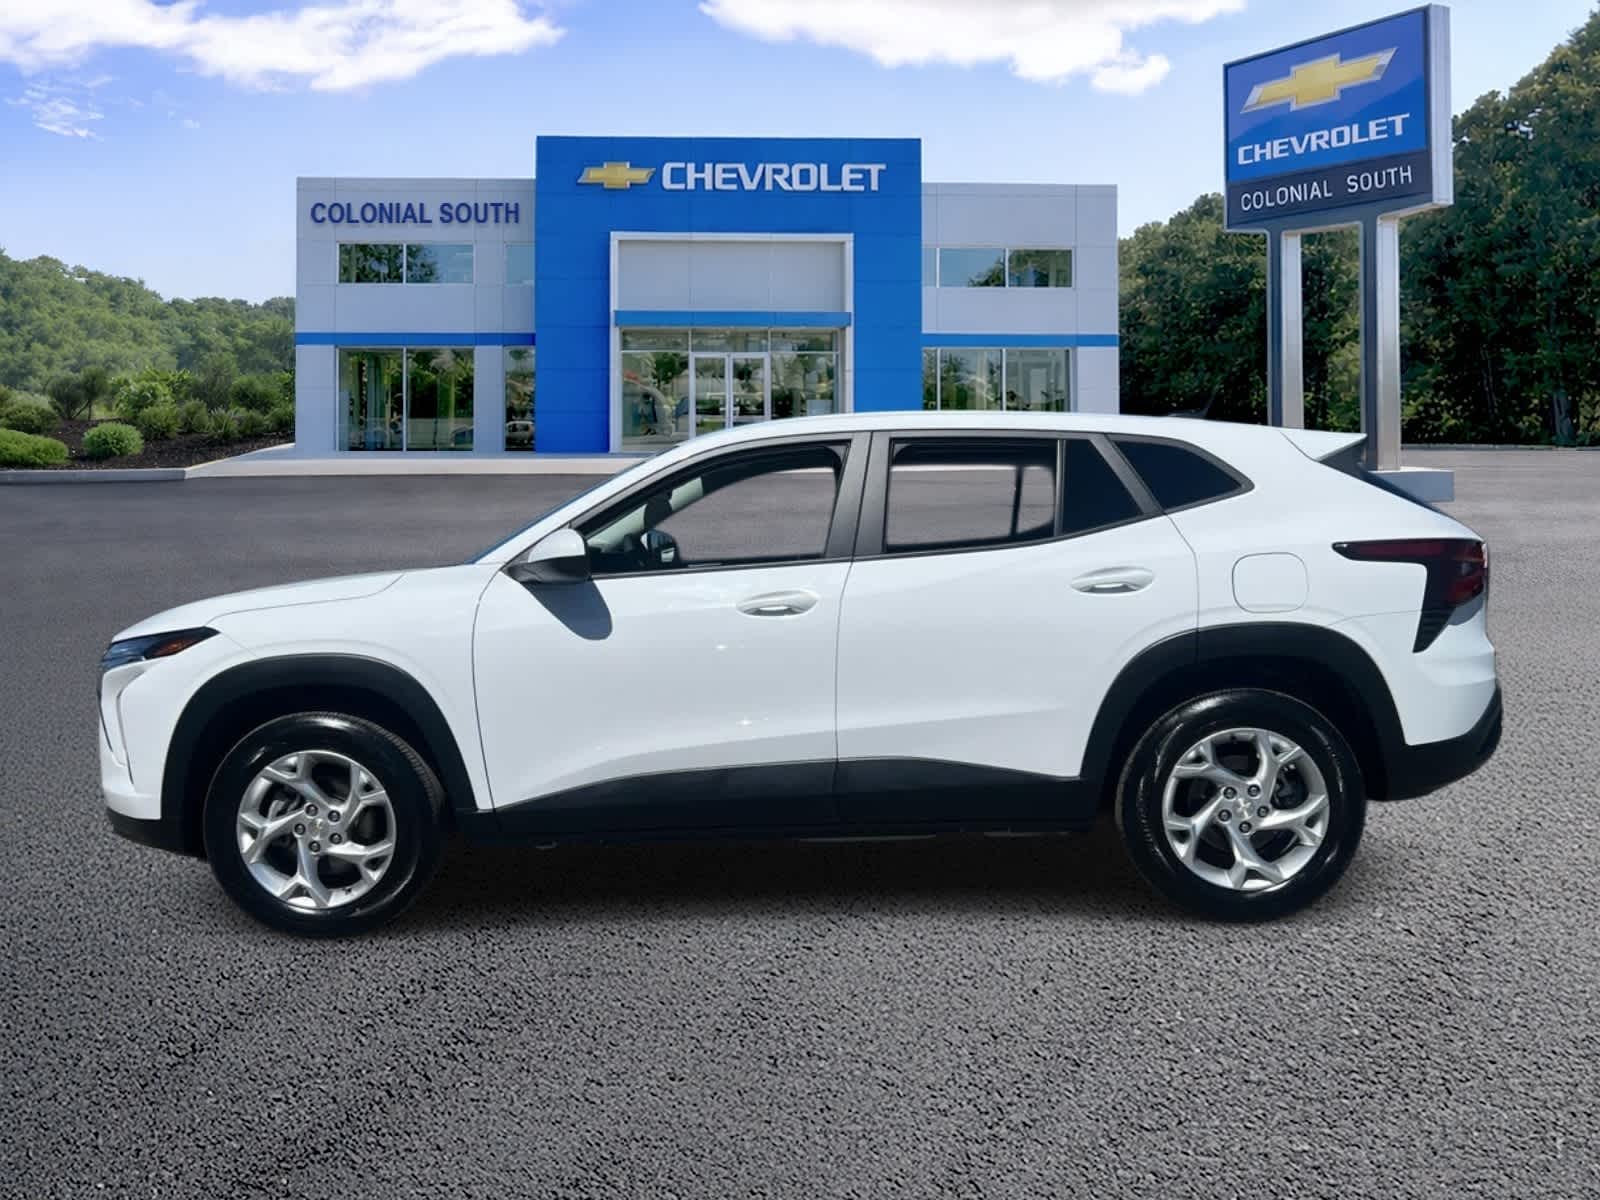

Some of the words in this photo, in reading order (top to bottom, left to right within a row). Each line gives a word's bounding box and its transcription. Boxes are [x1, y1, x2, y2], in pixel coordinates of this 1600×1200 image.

[1237, 113, 1410, 165] CHEVROLET
[661, 161, 887, 193] CHEVROLET
[1240, 179, 1333, 212] COLONIAL
[1346, 164, 1413, 193] SOUTH
[310, 202, 433, 225] COLONIAL
[439, 202, 520, 225] SOUTH
